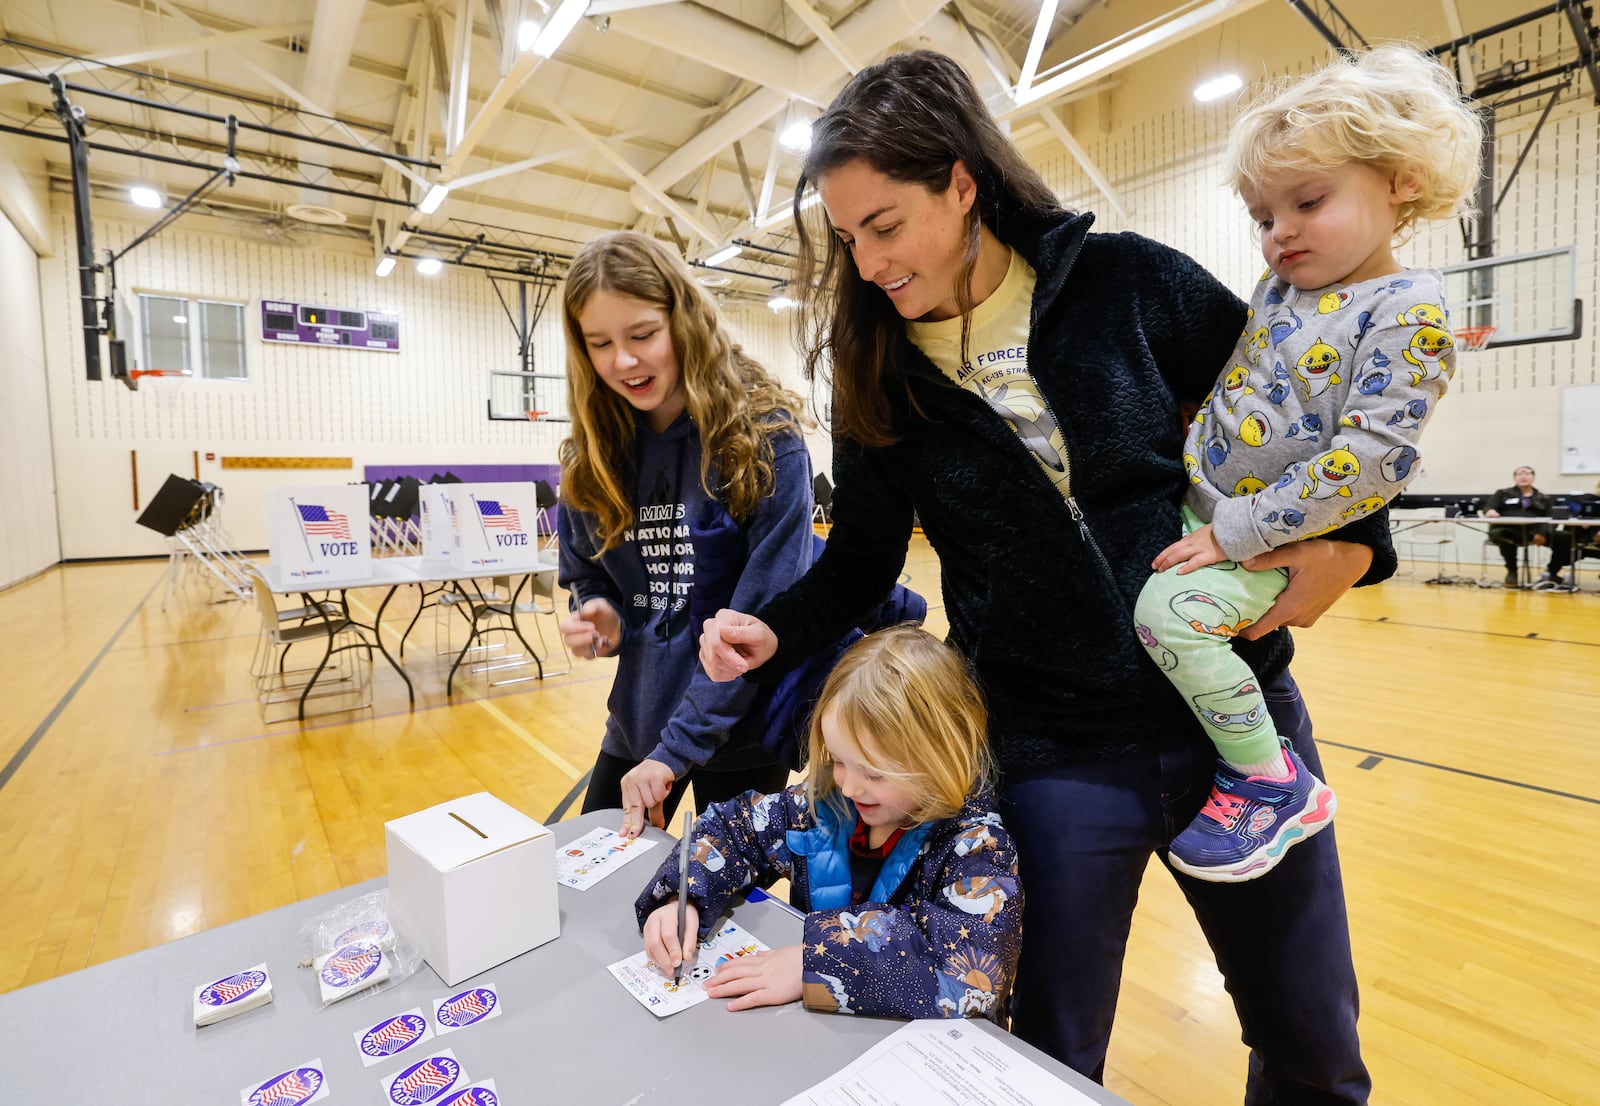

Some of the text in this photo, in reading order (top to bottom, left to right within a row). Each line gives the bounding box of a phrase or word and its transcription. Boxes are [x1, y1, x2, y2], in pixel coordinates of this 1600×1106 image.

[956, 347, 1025, 381] AIR FORCE
[981, 371, 1004, 385] KC-135
[495, 533, 528, 547] VOTE
[623, 524, 691, 542] NATIONA
[320, 541, 358, 557] VOTE
[649, 581, 695, 595] SOIET
[481, 991, 495, 1009] VOTER
[362, 1016, 424, 1056] FUTURE VOTER
[303, 1070, 320, 1092] VOTER
[391, 1059, 458, 1105] FUTURE VOTER
